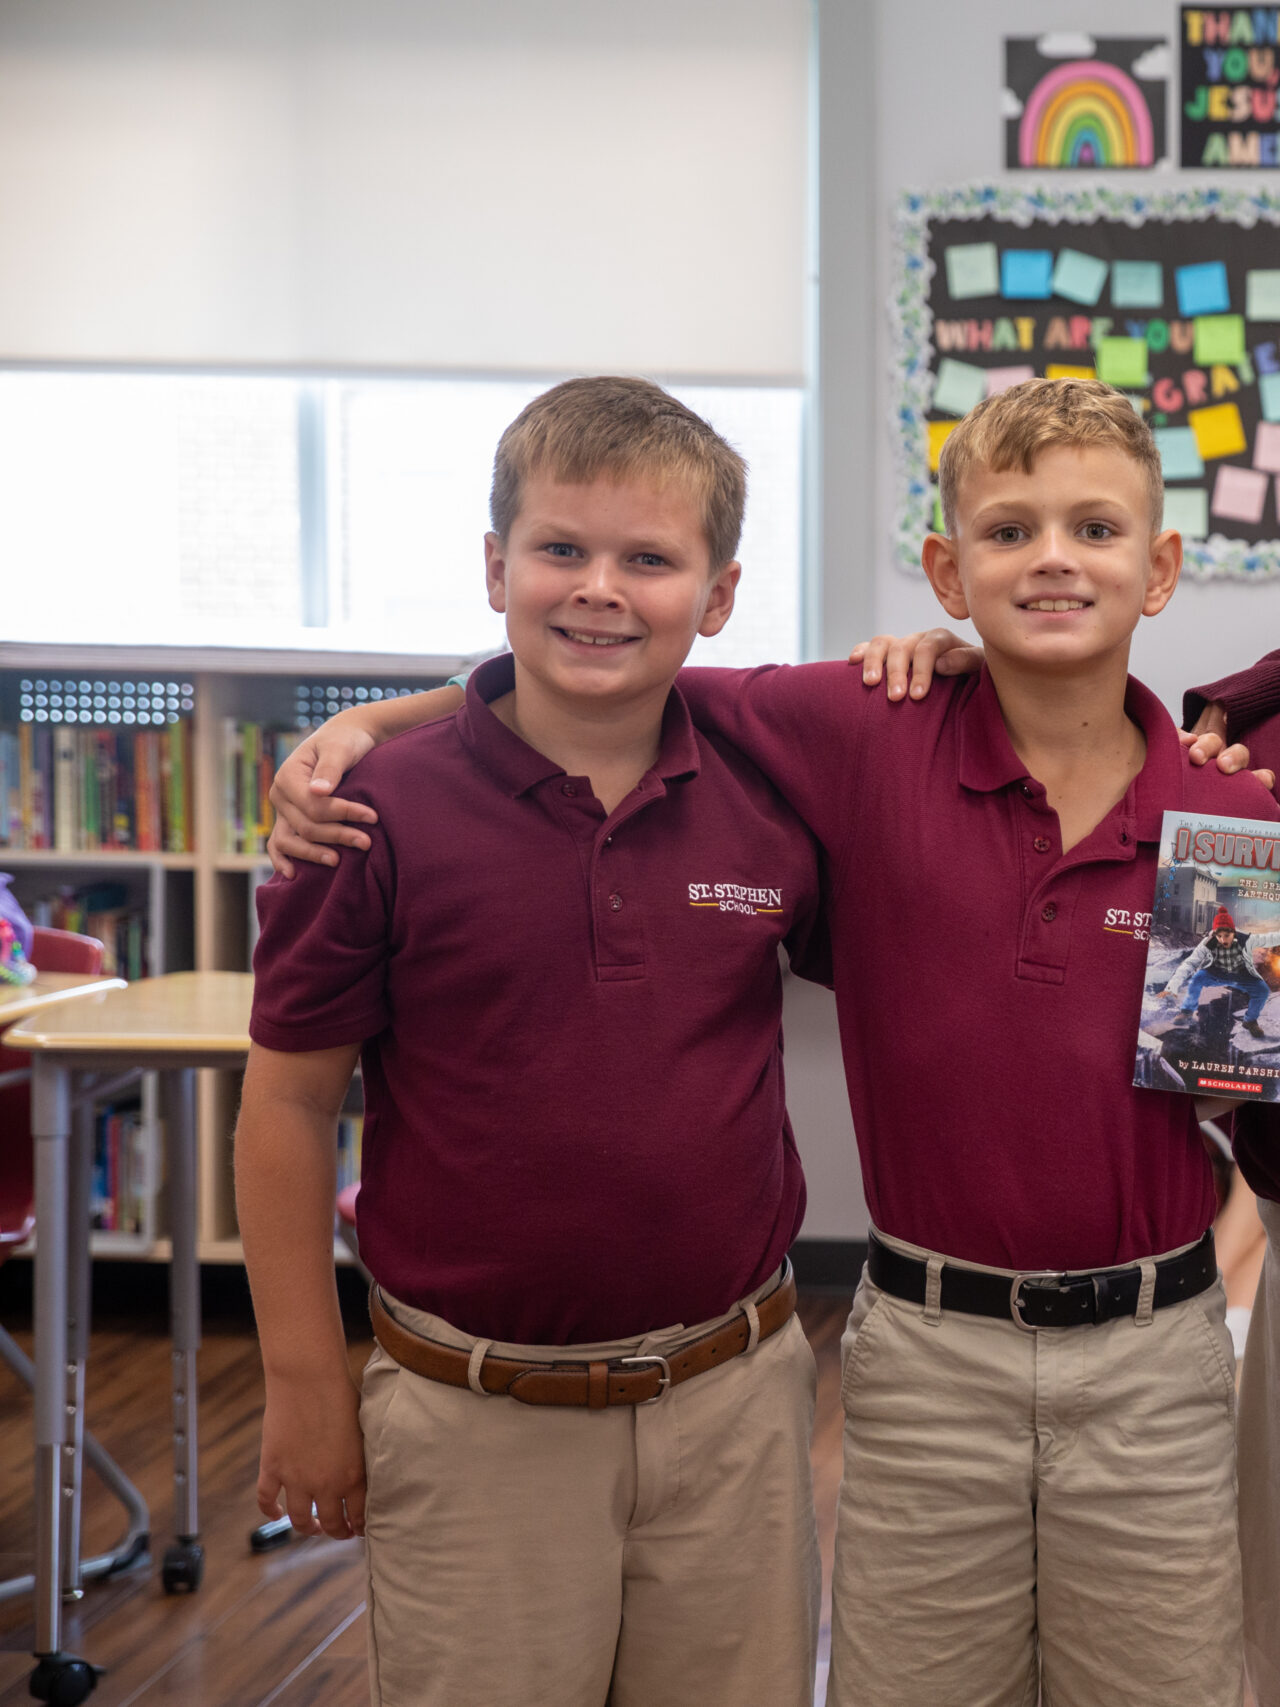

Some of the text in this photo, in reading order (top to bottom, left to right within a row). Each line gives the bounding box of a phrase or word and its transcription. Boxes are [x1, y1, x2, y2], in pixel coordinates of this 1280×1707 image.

[1203, 46, 1280, 89] YOU,
[935, 317, 1035, 350] WHAT
[1176, 828, 1191, 861] I
[1239, 878, 1259, 889] THE
[688, 883, 783, 906] ST. STEPHEN
[719, 900, 758, 915] SCHOOL
[1104, 908, 1131, 926] ST.
[1178, 1060, 1189, 1070] by
[1191, 1061, 1235, 1073] LAUREN
[1207, 1080, 1261, 1092] SCHOLASTIC
